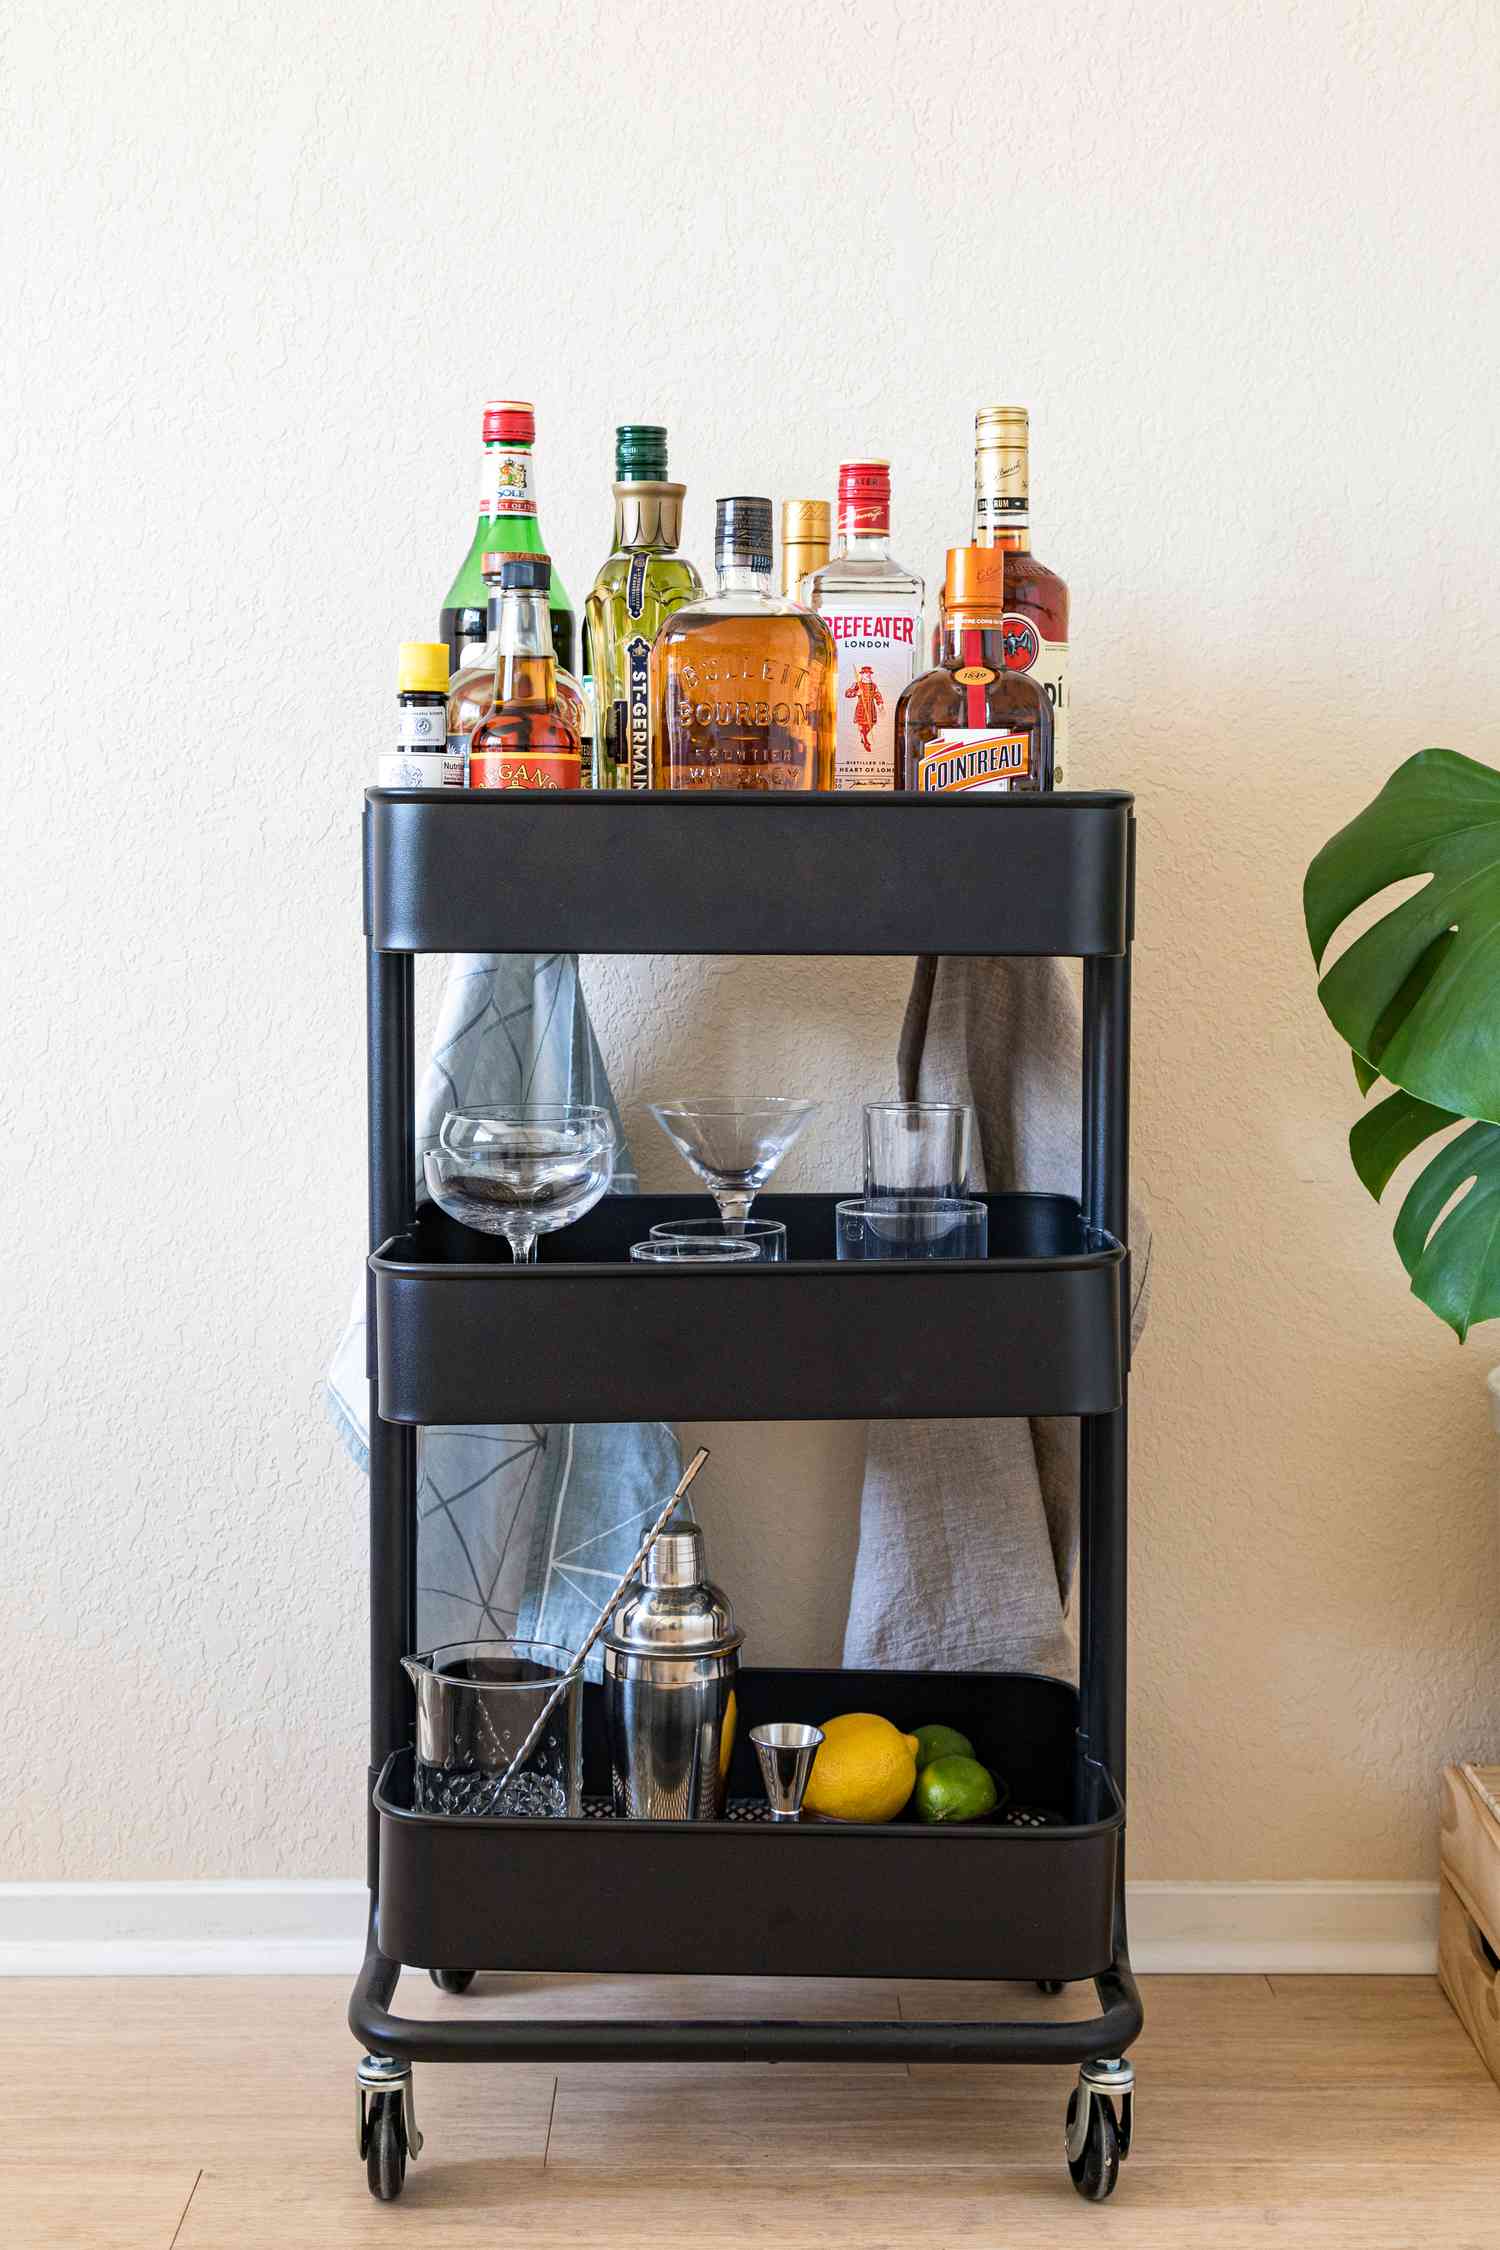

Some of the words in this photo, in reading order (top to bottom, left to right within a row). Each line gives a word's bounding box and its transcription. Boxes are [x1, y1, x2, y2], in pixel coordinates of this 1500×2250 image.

[963, 672, 987, 680] 1849
[679, 701, 810, 727] BOURBON
[924, 743, 1023, 792] COINTREAU
